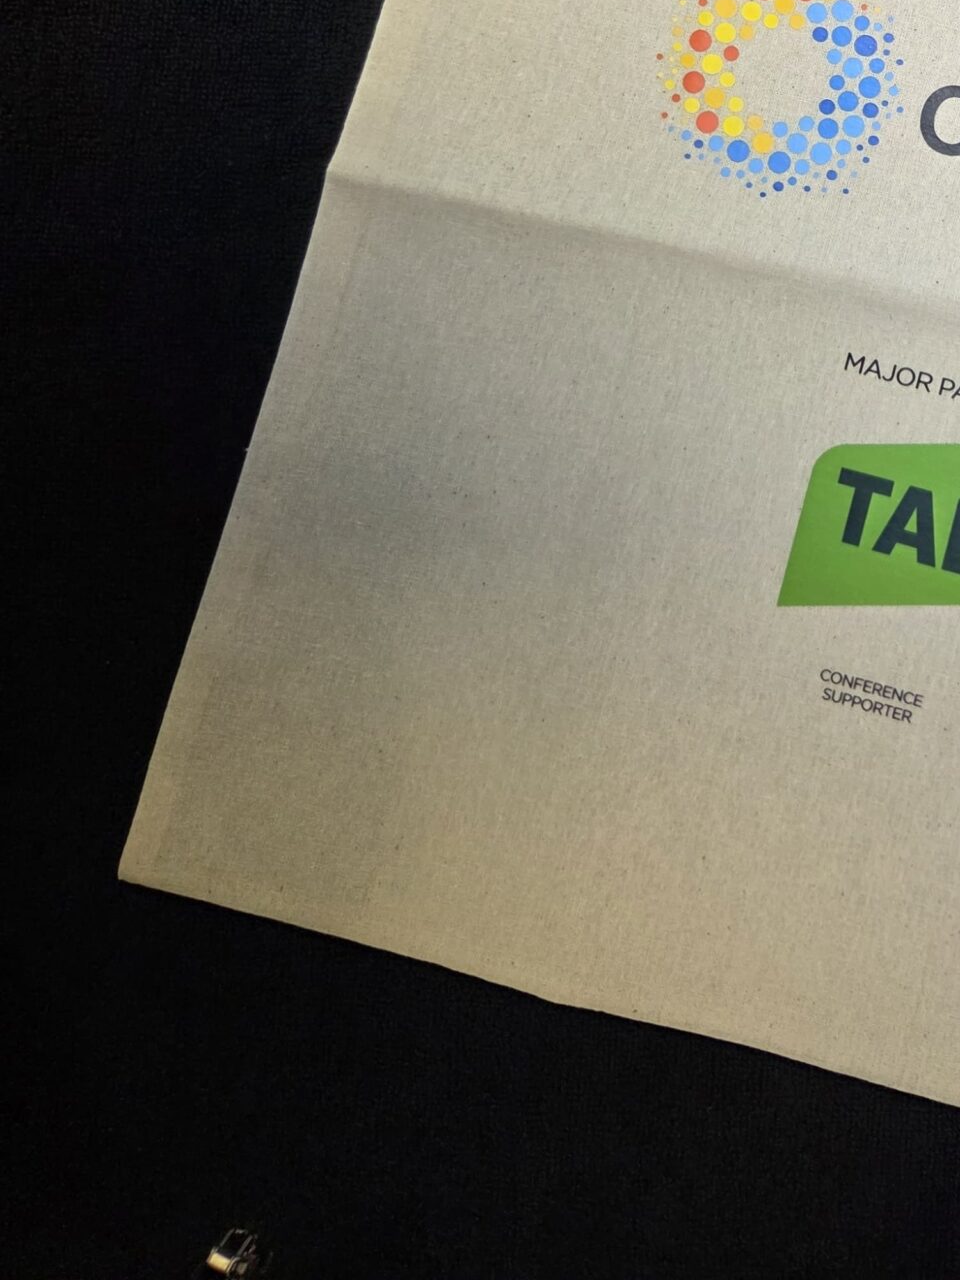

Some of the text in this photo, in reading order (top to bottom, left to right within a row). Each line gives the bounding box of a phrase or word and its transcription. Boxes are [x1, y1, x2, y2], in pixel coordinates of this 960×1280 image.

[843, 352, 934, 393] MAJOR
[819, 668, 924, 708] CONFERENCE
[821, 687, 914, 724] SUPPORTER
